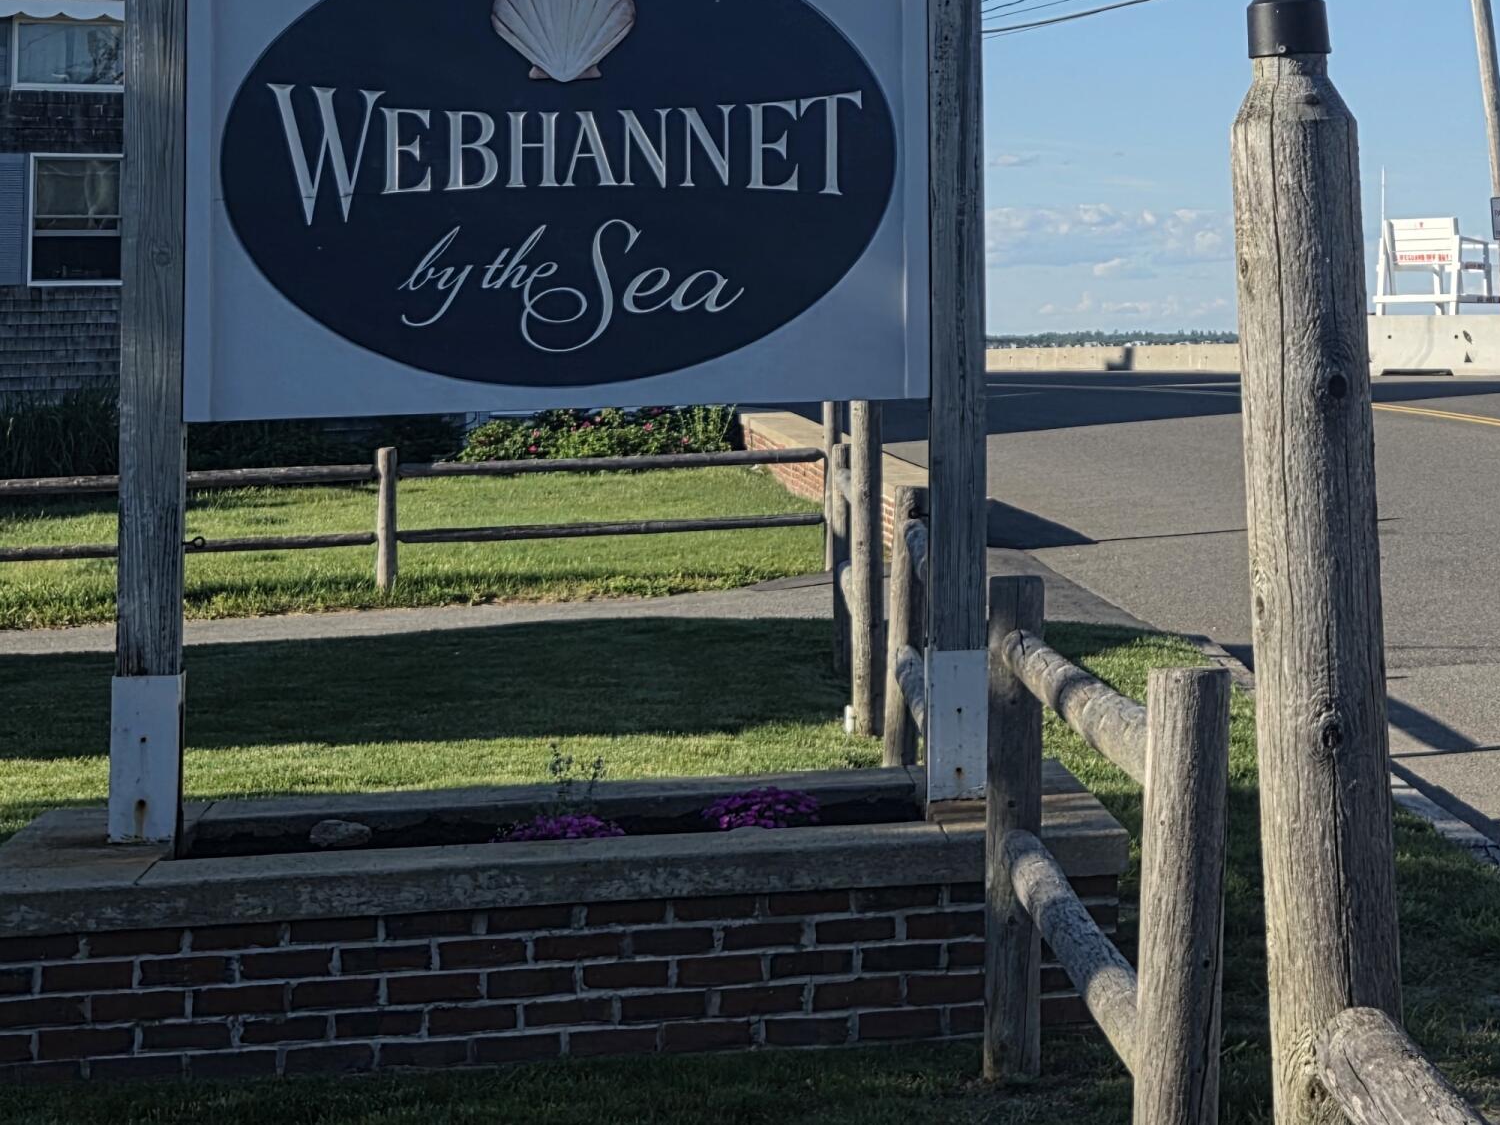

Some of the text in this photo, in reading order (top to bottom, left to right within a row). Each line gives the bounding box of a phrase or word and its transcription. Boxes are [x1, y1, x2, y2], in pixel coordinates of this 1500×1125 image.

[266, 83, 863, 226] WEBHANNET
[397, 219, 744, 352] by the Sea
